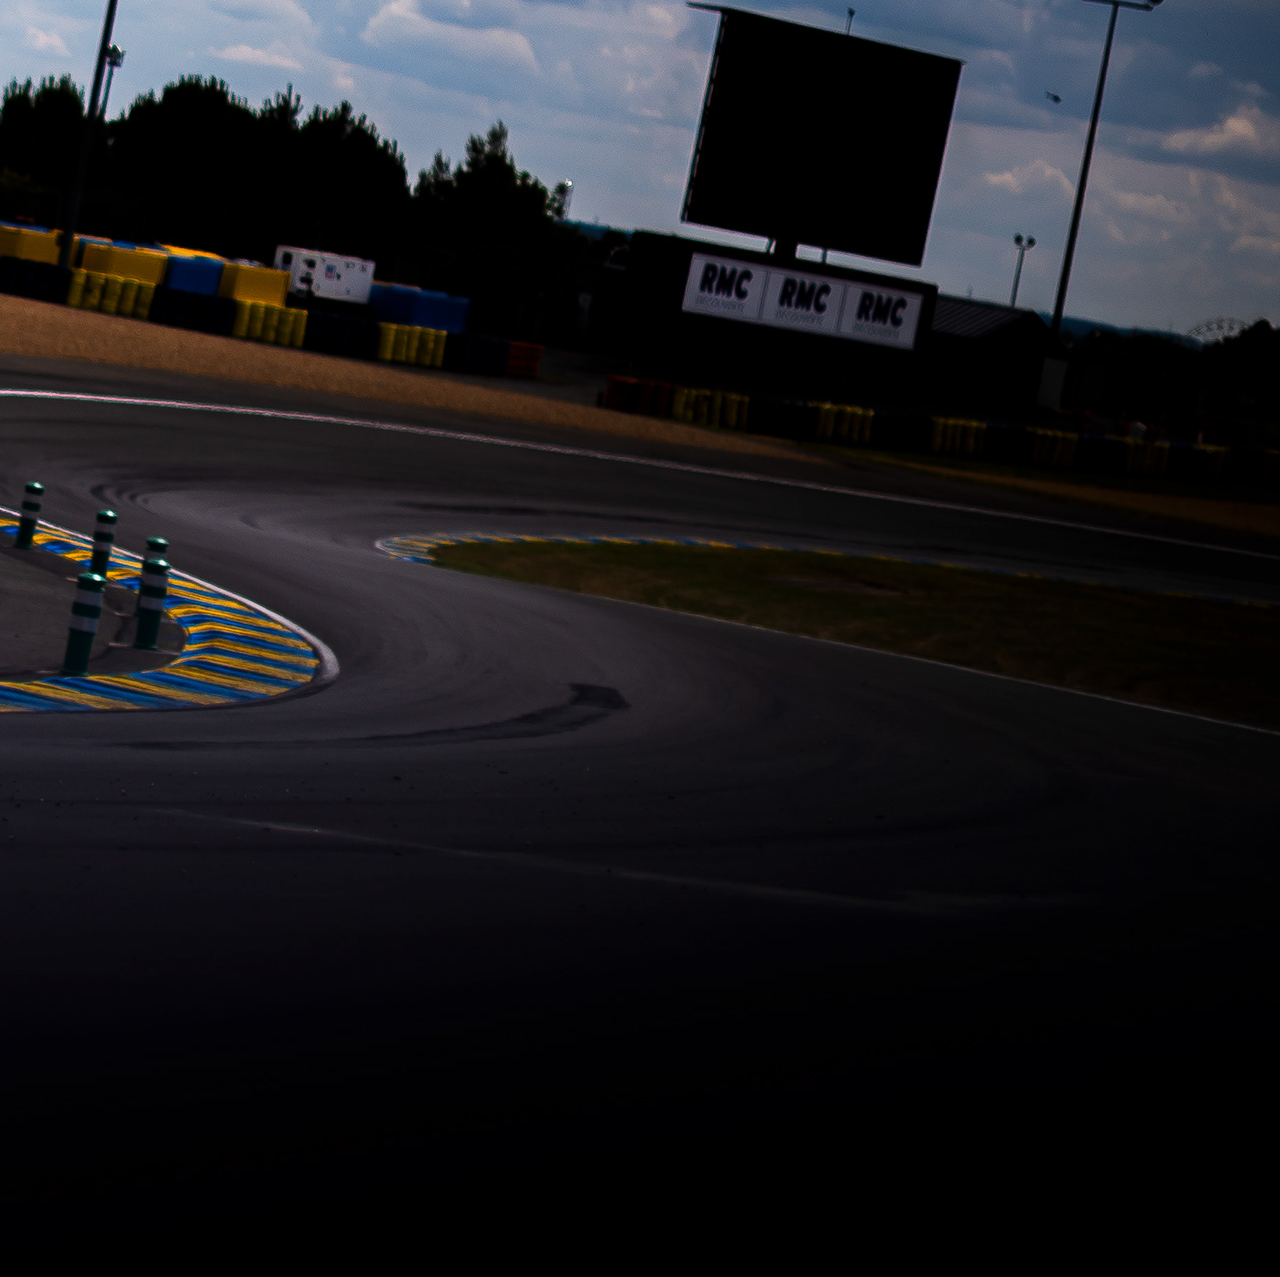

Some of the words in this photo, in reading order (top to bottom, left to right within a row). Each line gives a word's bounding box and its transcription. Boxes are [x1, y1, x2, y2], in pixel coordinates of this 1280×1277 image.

[700, 263, 752, 299] RMC
[779, 278, 831, 313] RMC
[857, 292, 907, 327] RMC
